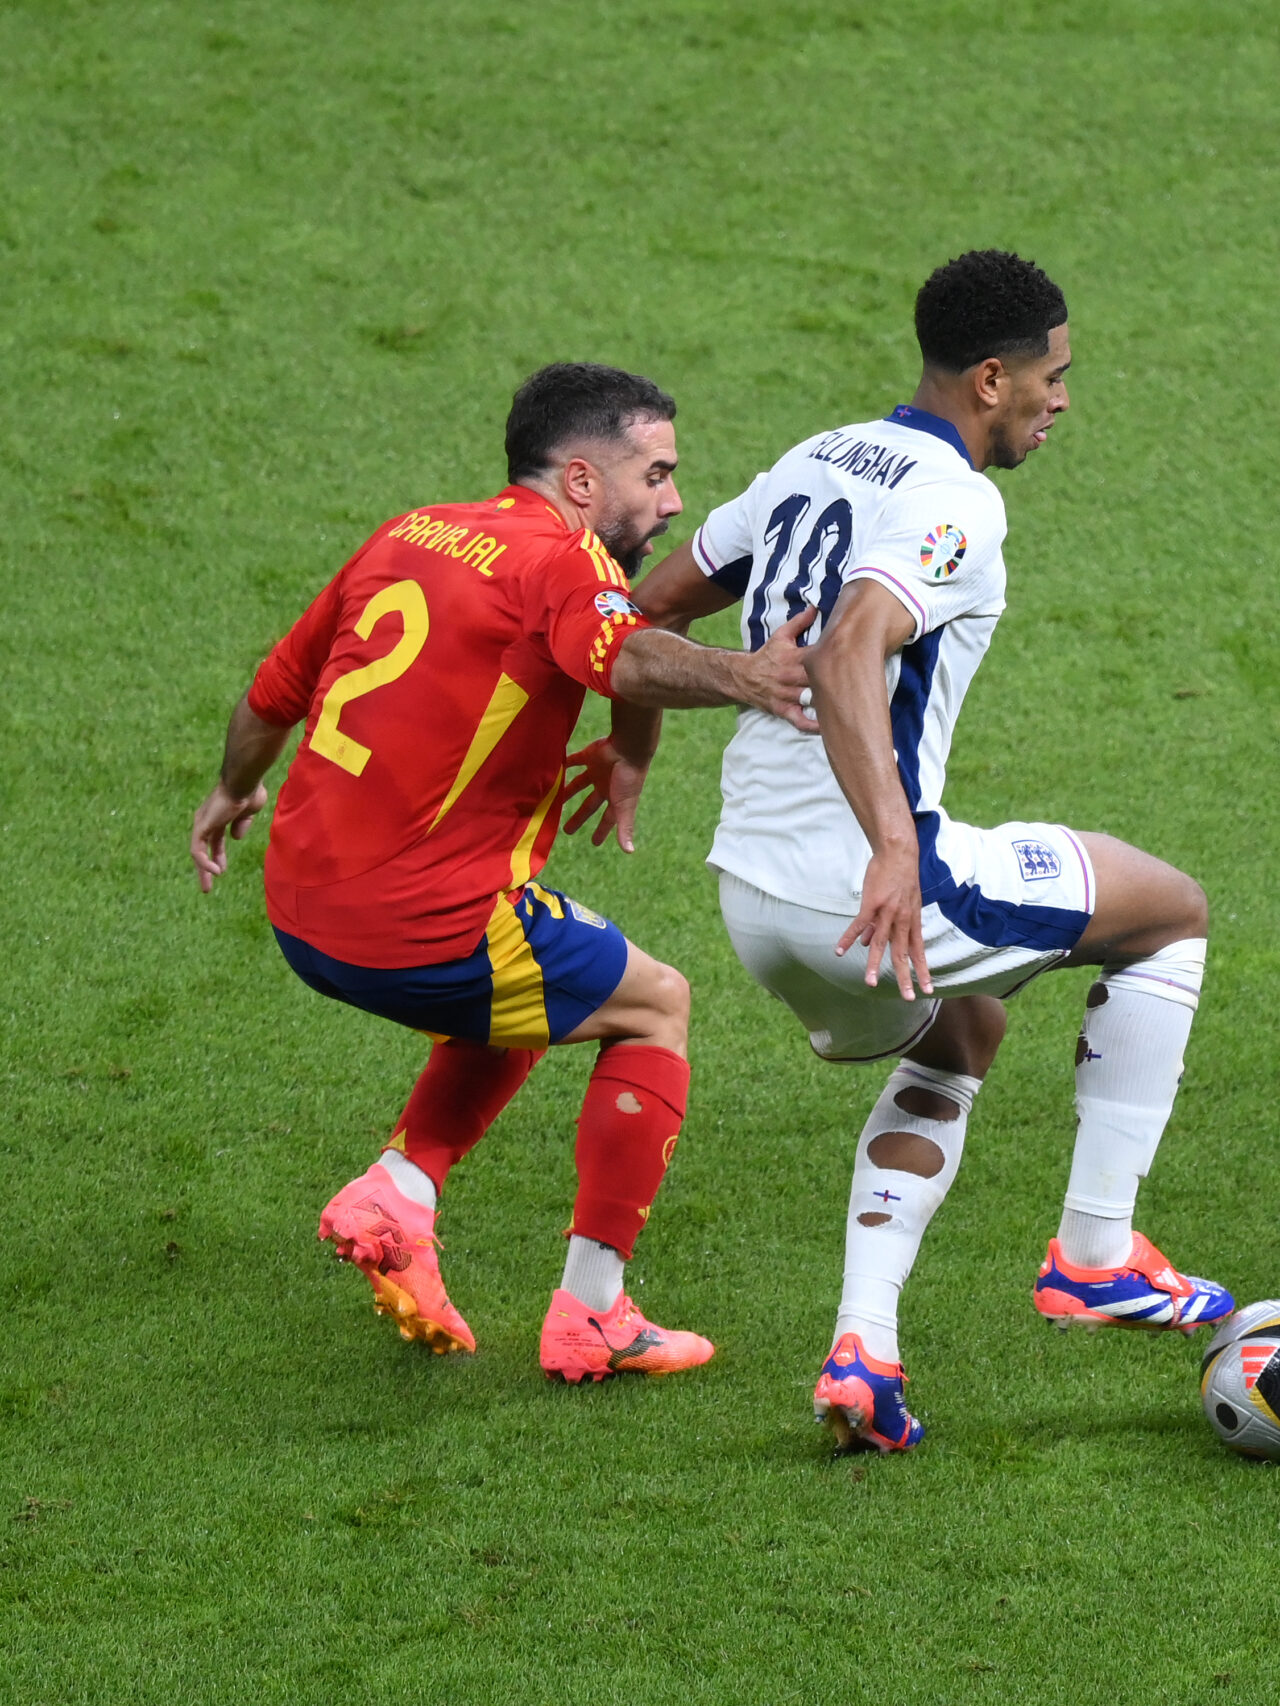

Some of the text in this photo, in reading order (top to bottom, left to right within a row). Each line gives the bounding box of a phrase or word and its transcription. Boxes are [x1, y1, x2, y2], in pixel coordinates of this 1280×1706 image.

[806, 432, 918, 490] ELLINGHAM
[388, 512, 507, 577] CARVAJAL
[748, 493, 852, 653] 10
[309, 579, 429, 777] 2
